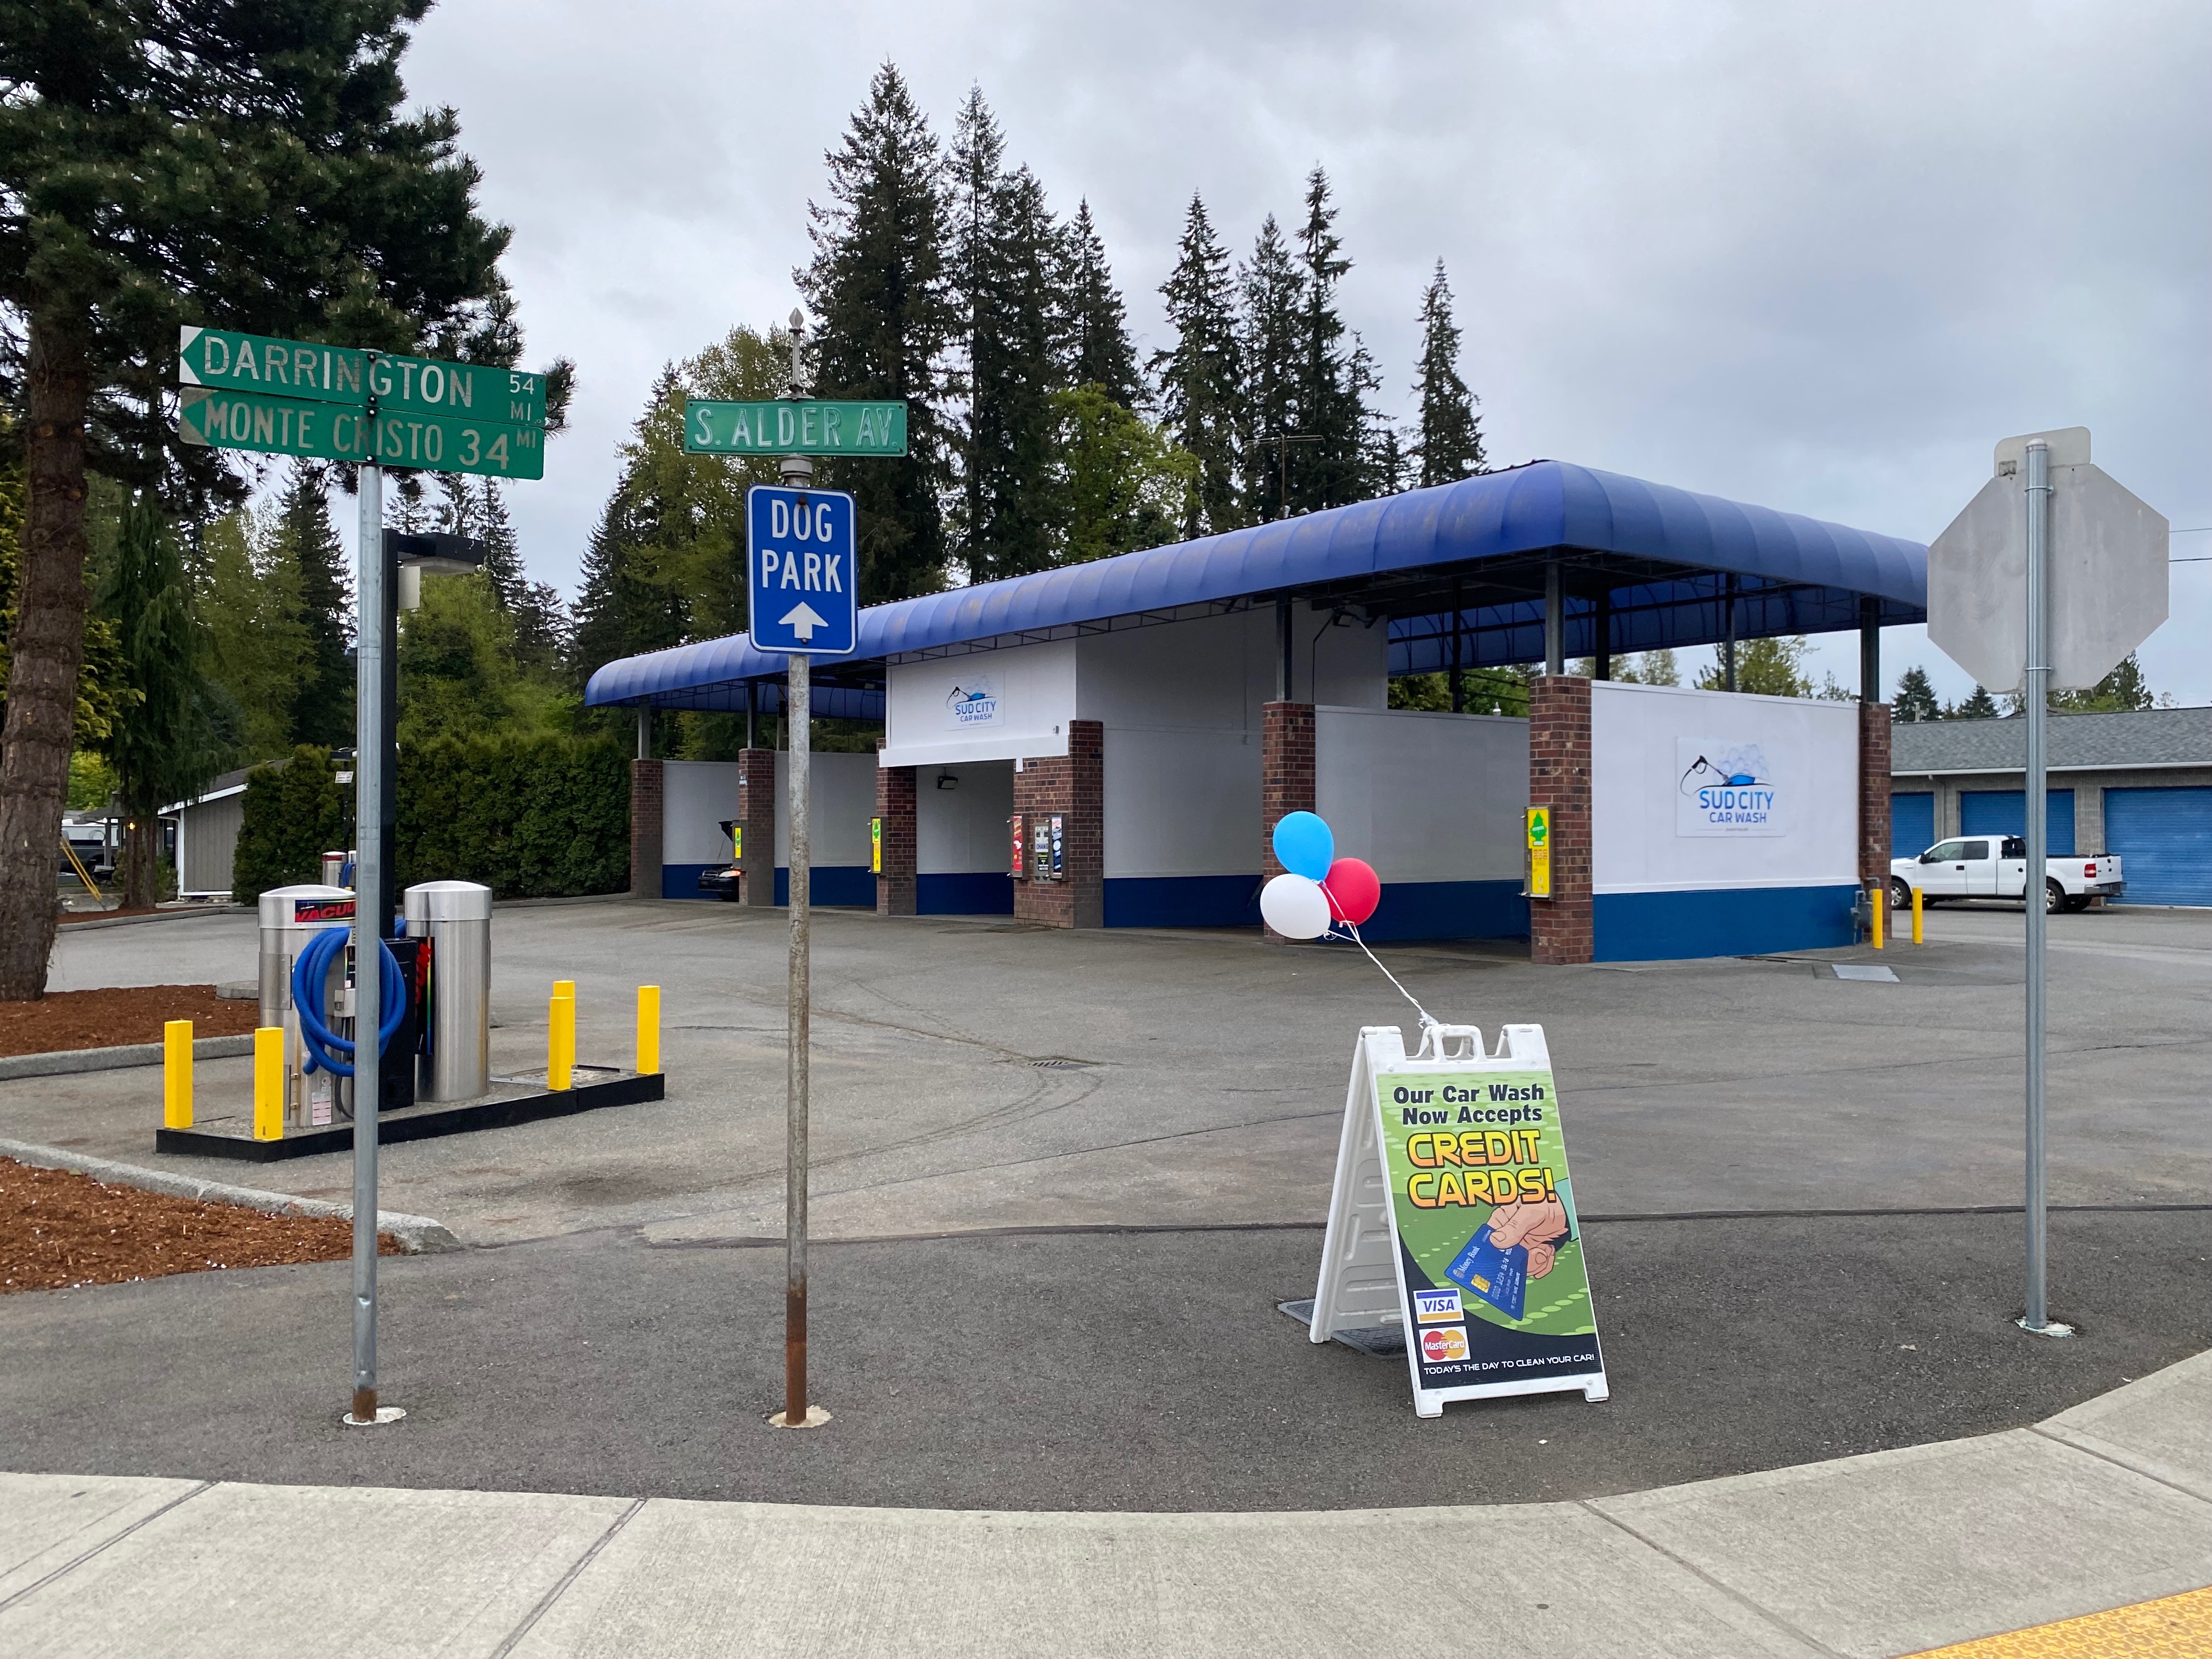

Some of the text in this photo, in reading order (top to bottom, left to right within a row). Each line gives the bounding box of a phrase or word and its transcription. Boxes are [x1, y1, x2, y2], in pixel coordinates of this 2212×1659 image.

[205, 336, 534, 408] DARRINGTON 54
[511, 401, 531, 422] MI
[204, 398, 537, 470] MONTE CRISTO 34 MI
[695, 406, 898, 448] S. ALDER AV.
[771, 499, 833, 543] DOG
[761, 549, 843, 593] PARK
[955, 701, 997, 715] SUD CITY
[1699, 790, 1774, 810] SUD CITY
[1709, 812, 1767, 823] CAR WASH
[295, 900, 356, 922] VACUU
[1393, 1083, 1544, 1104] Our Car Wash
[1402, 1104, 1543, 1126] Now Accepts
[1407, 1128, 1541, 1168] CREDIT
[1407, 1167, 1557, 1210] CARDS!
[1457, 1246, 1481, 1273] Money Bank
[1422, 1299, 1455, 1312] VISA
[1425, 1340, 1465, 1351] MasterCard
[1424, 1364, 1462, 1375] TODAY'S
[1463, 1363, 1480, 1372] THE
[1482, 1362, 1499, 1370] DAY
[1516, 1358, 1545, 1367] CLEAN
[1546, 1356, 1572, 1364] YOUR
[1573, 1353, 1595, 1362] CAR!
